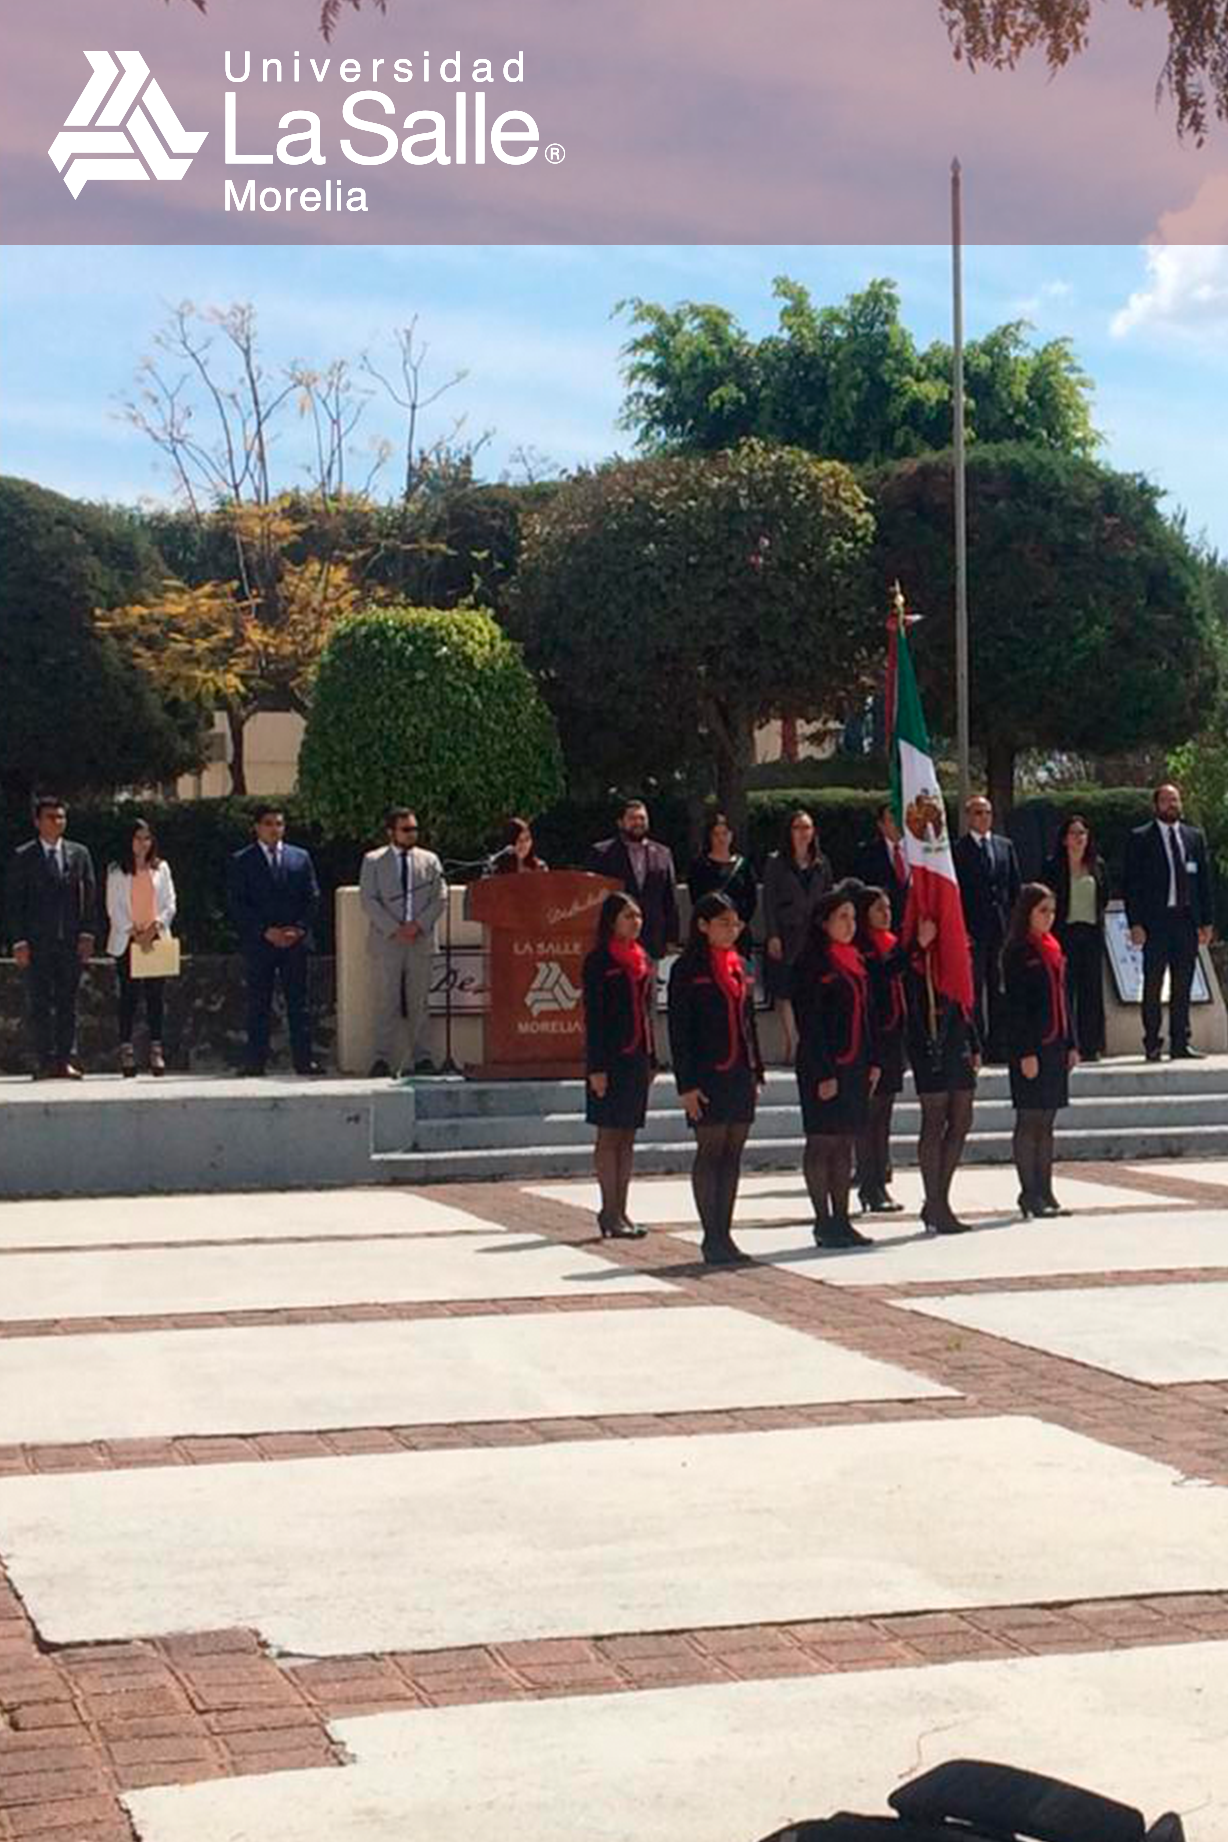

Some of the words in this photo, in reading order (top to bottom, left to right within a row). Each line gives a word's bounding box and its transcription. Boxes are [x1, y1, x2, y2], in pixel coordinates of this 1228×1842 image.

[513, 942, 533, 954] LA
[537, 942, 582, 954] SALLE
[518, 1021, 582, 1034] MORELIA
